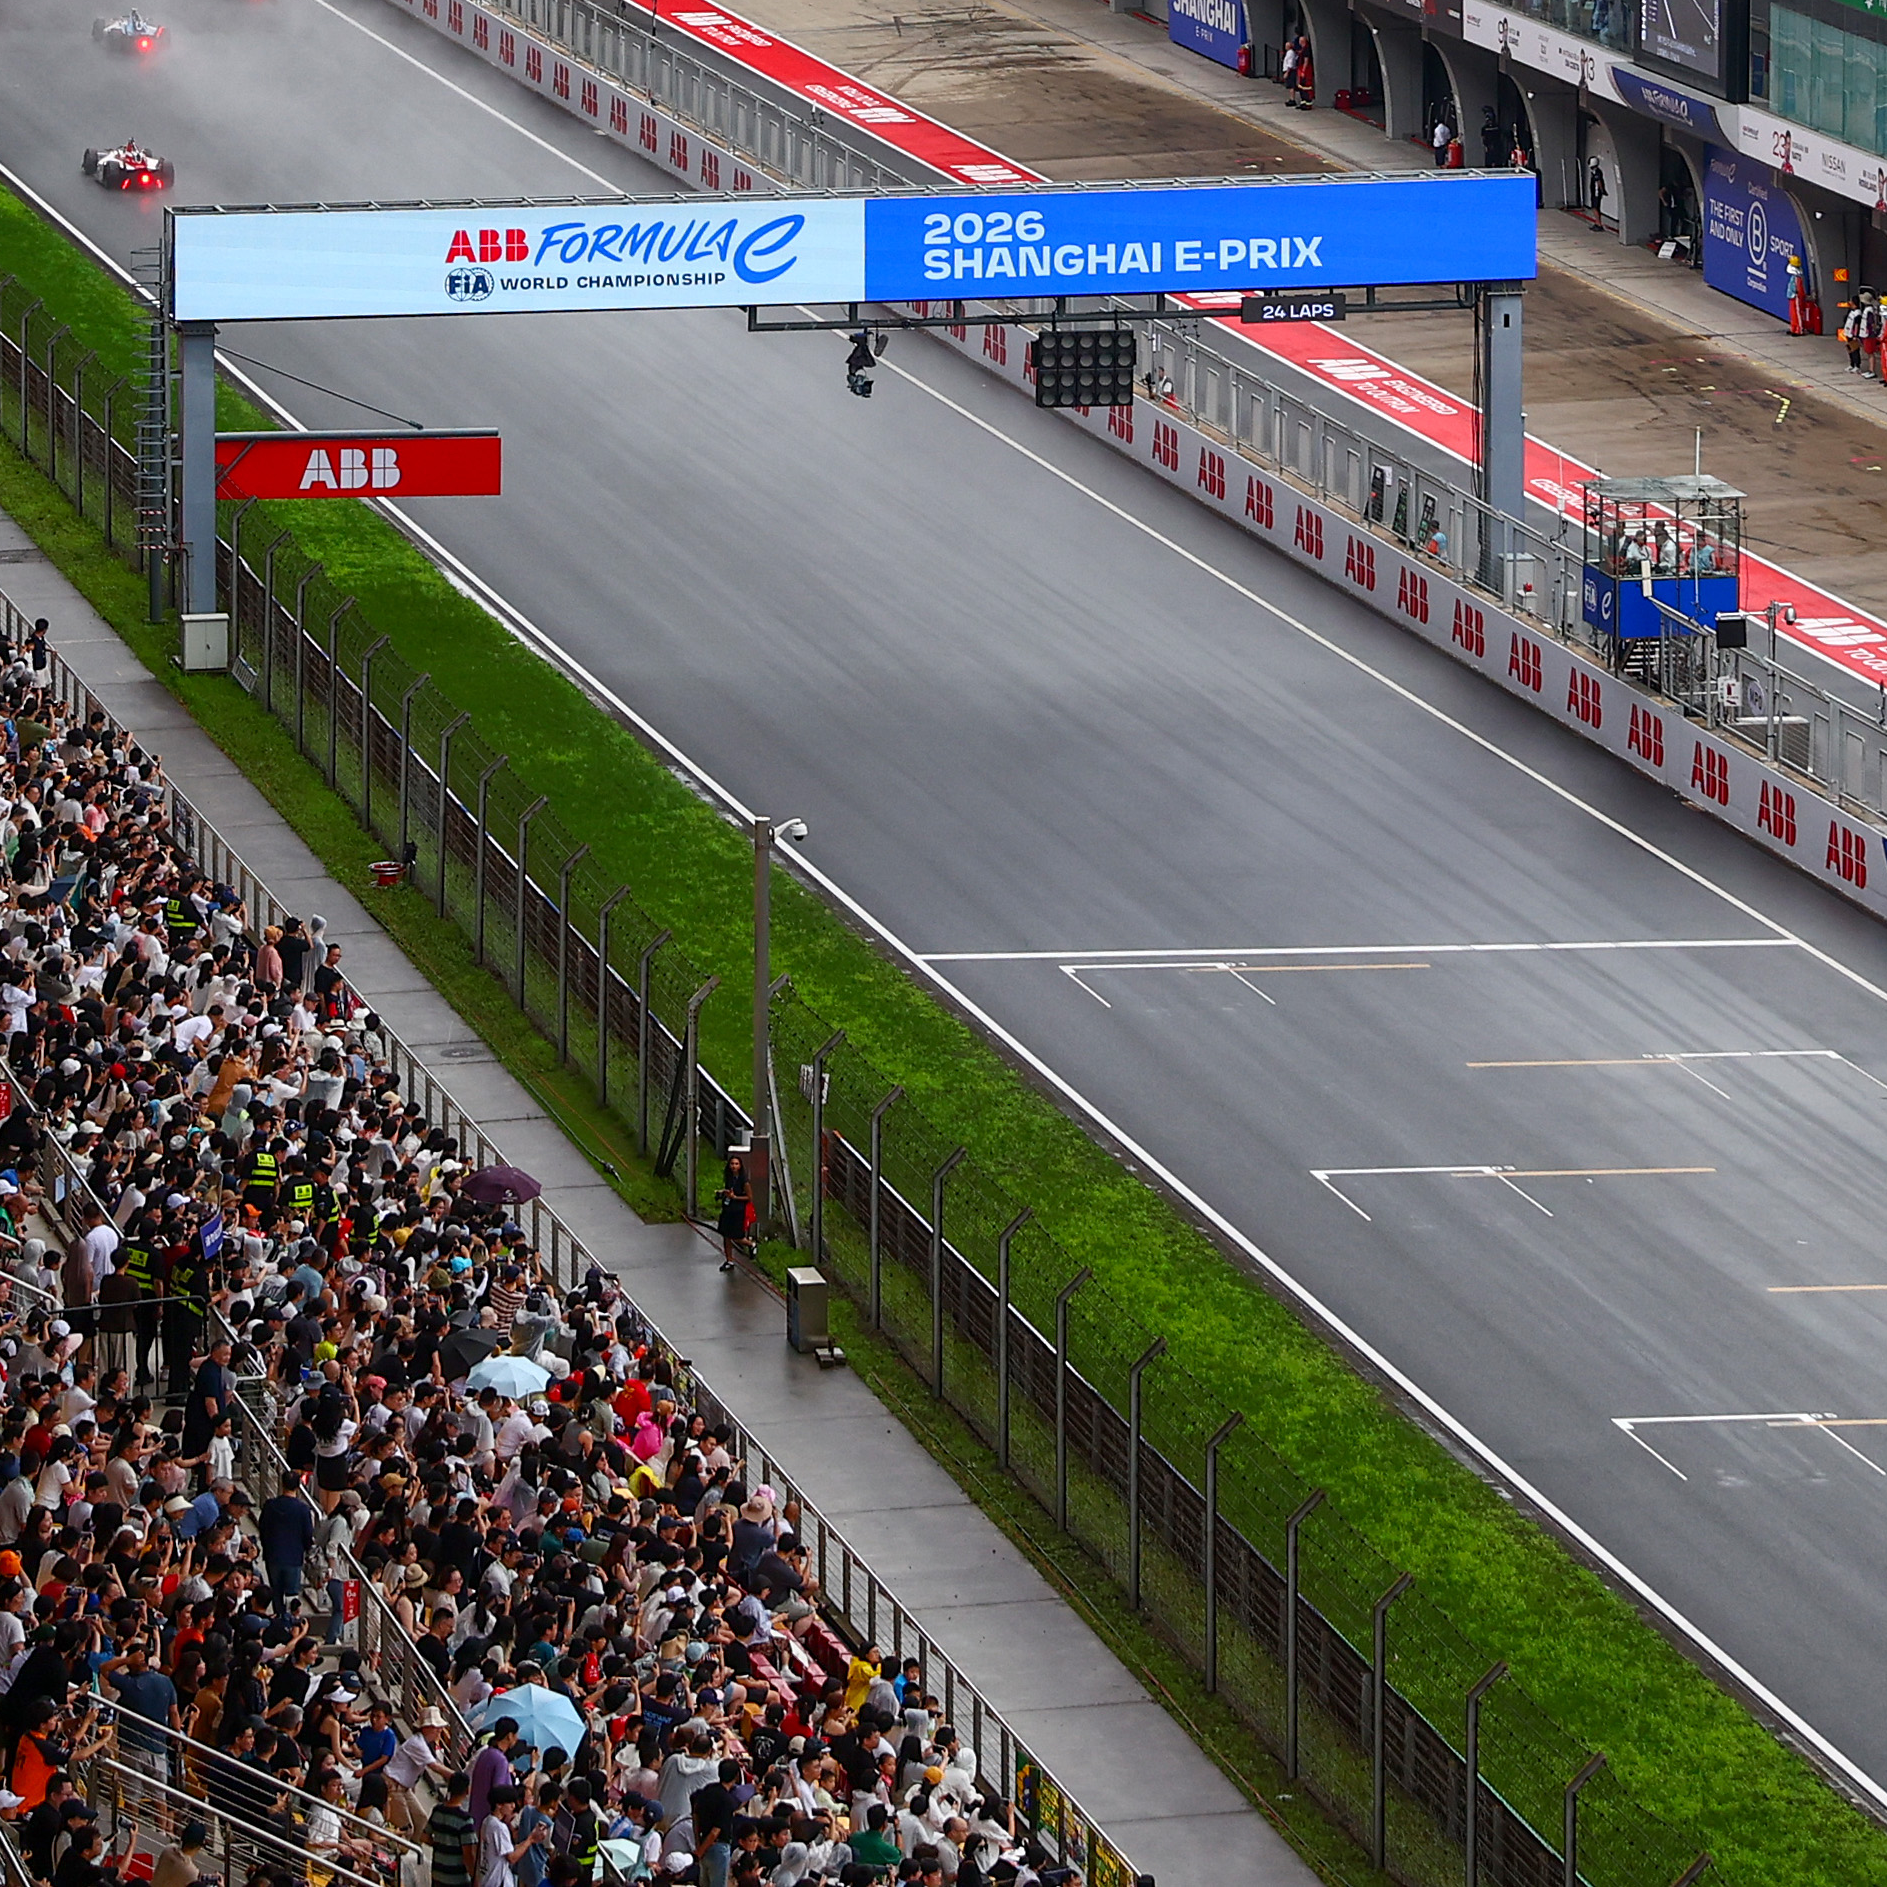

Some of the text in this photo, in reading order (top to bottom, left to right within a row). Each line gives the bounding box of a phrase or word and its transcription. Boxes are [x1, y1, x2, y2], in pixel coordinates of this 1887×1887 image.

[474, 15, 490, 50] ABB
[526, 46, 543, 82] ABB
[581, 82, 599, 117] ABB
[640, 115, 657, 152] ABB
[702, 152, 721, 189] ABB
[924, 211, 1045, 245] 2026
[1709, 198, 1744, 228] THE FIRST
[445, 229, 529, 263] ABB
[534, 220, 734, 266] FORMULA
[1709, 219, 1744, 248] AND ONLY
[1770, 234, 1794, 259] SPORT
[924, 236, 1322, 281] SHANGHAI E-PRIX
[501, 277, 568, 291] WORLD
[577, 272, 725, 289] CHAMPIONSHIP
[1262, 303, 1334, 320] 24 LAPS
[1153, 423, 1179, 471] ABB
[299, 448, 400, 489] ABB
[1197, 449, 1226, 500] ABB
[1293, 505, 1324, 560] ABB
[1346, 535, 1377, 591] ABB
[1451, 599, 1486, 658] ABB
[1794, 618, 1887, 646] ABB
[1508, 633, 1543, 693] ABB
[1843, 648, 1875, 660] TO
[1567, 668, 1603, 729] ABB
[1627, 704, 1665, 767] ABB
[1690, 741, 1730, 806] ABB
[1826, 820, 1867, 889] ABB
